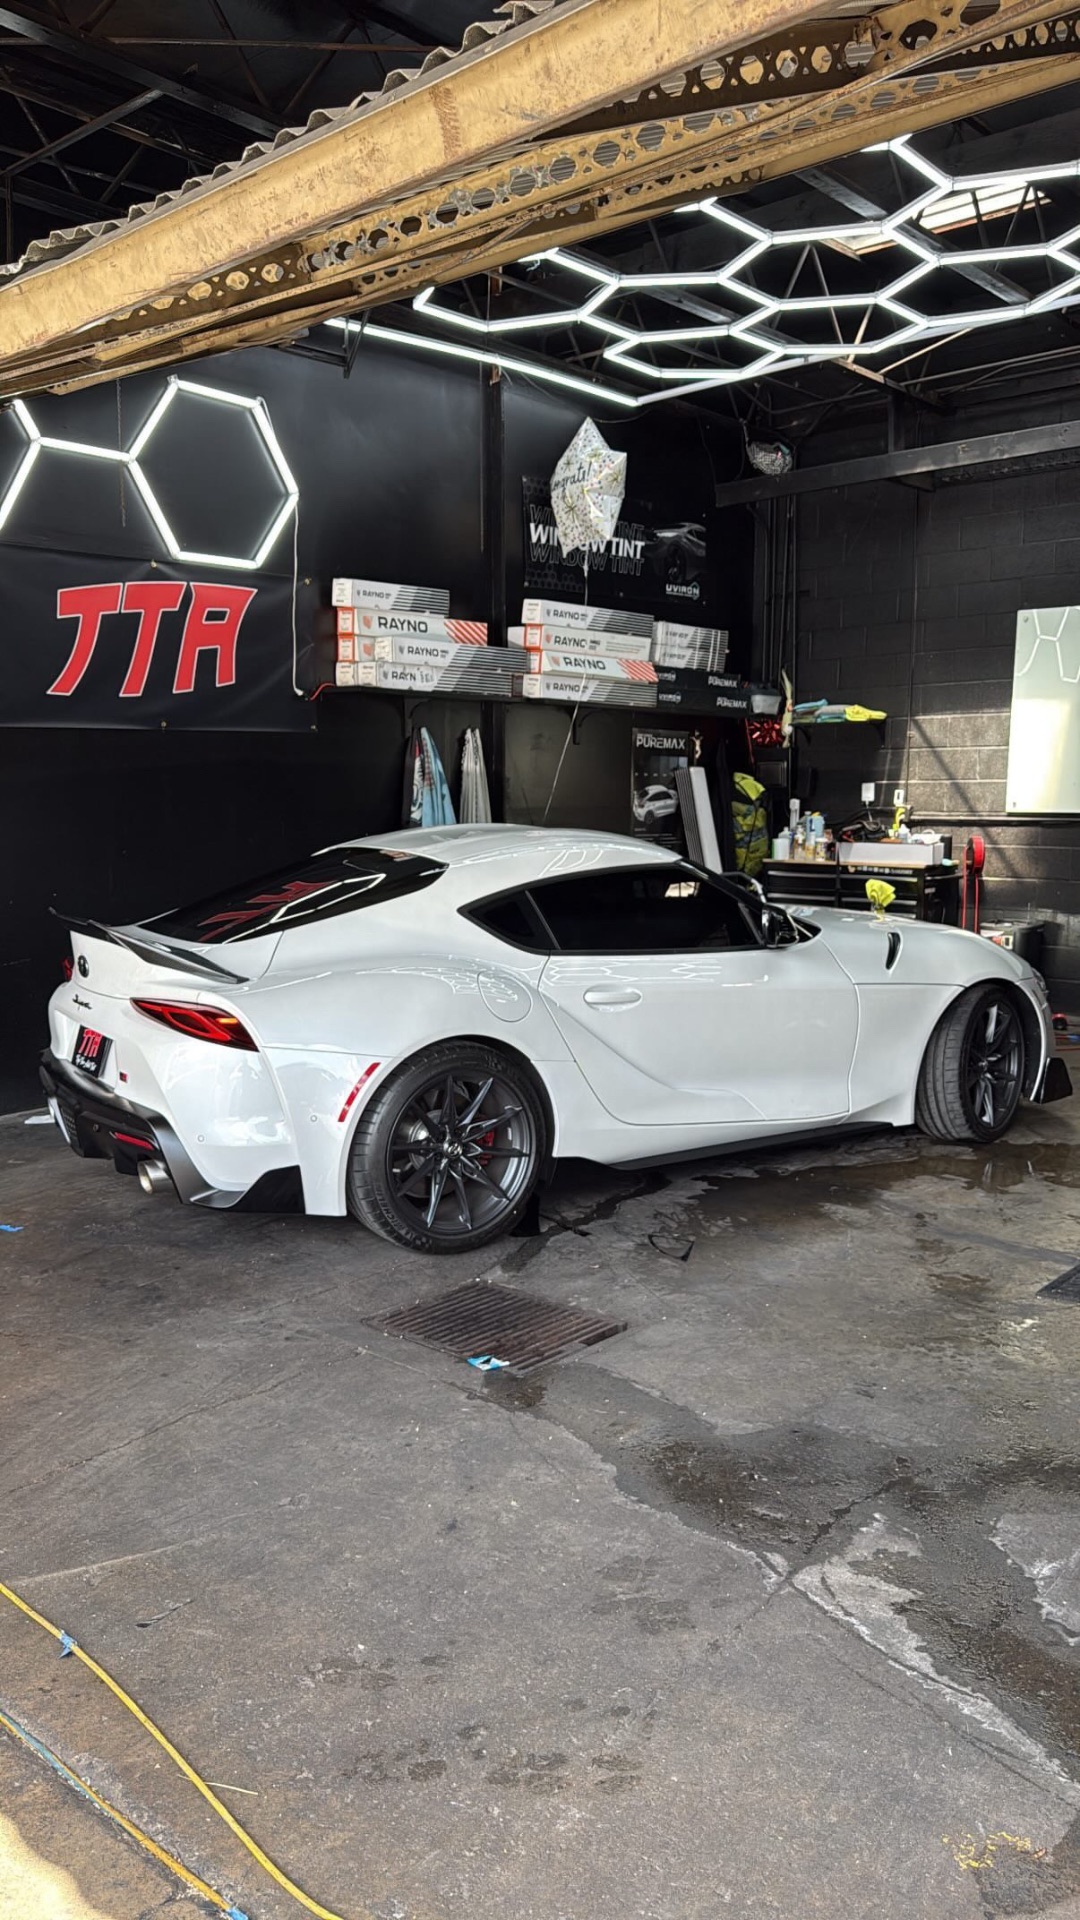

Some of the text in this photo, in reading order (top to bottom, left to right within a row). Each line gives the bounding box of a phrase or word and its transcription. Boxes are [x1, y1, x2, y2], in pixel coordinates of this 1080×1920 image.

[610, 537, 645, 559] TINT
[362, 590, 385, 599] RAYNO
[553, 609, 580, 621] RAYNO
[377, 616, 428, 633] RAYNO
[46, 581, 258, 697] TTA
[407, 646, 439, 657] RAYNO
[563, 656, 606, 670] RAYNO
[391, 671, 417, 682] RAYN
[708, 676, 738, 688] PUREMAX
[553, 682, 580, 693] RAYNO
[716, 697, 747, 708] PUREMAX
[636, 735, 686, 750] PUREMAX
